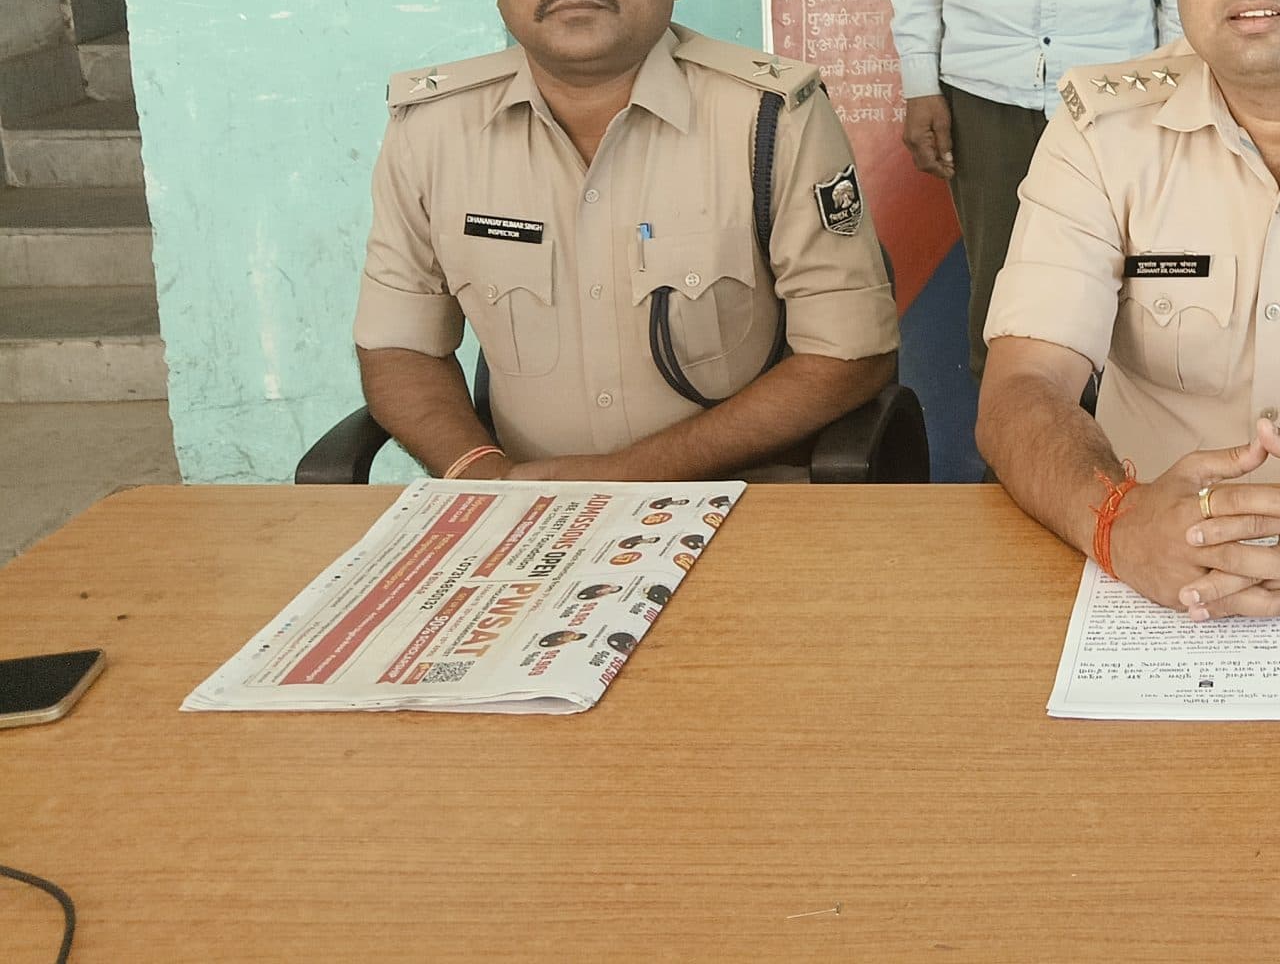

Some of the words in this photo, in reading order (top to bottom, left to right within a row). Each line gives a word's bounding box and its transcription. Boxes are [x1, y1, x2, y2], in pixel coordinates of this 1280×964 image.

[781, 12, 796, 26] 5.
[548, 493, 615, 549] ADMISSIONS
[513, 534, 555, 570] Foundation
[526, 551, 568, 577] OPEN
[418, 615, 450, 634] 90%
[450, 582, 543, 657] PWSAT
